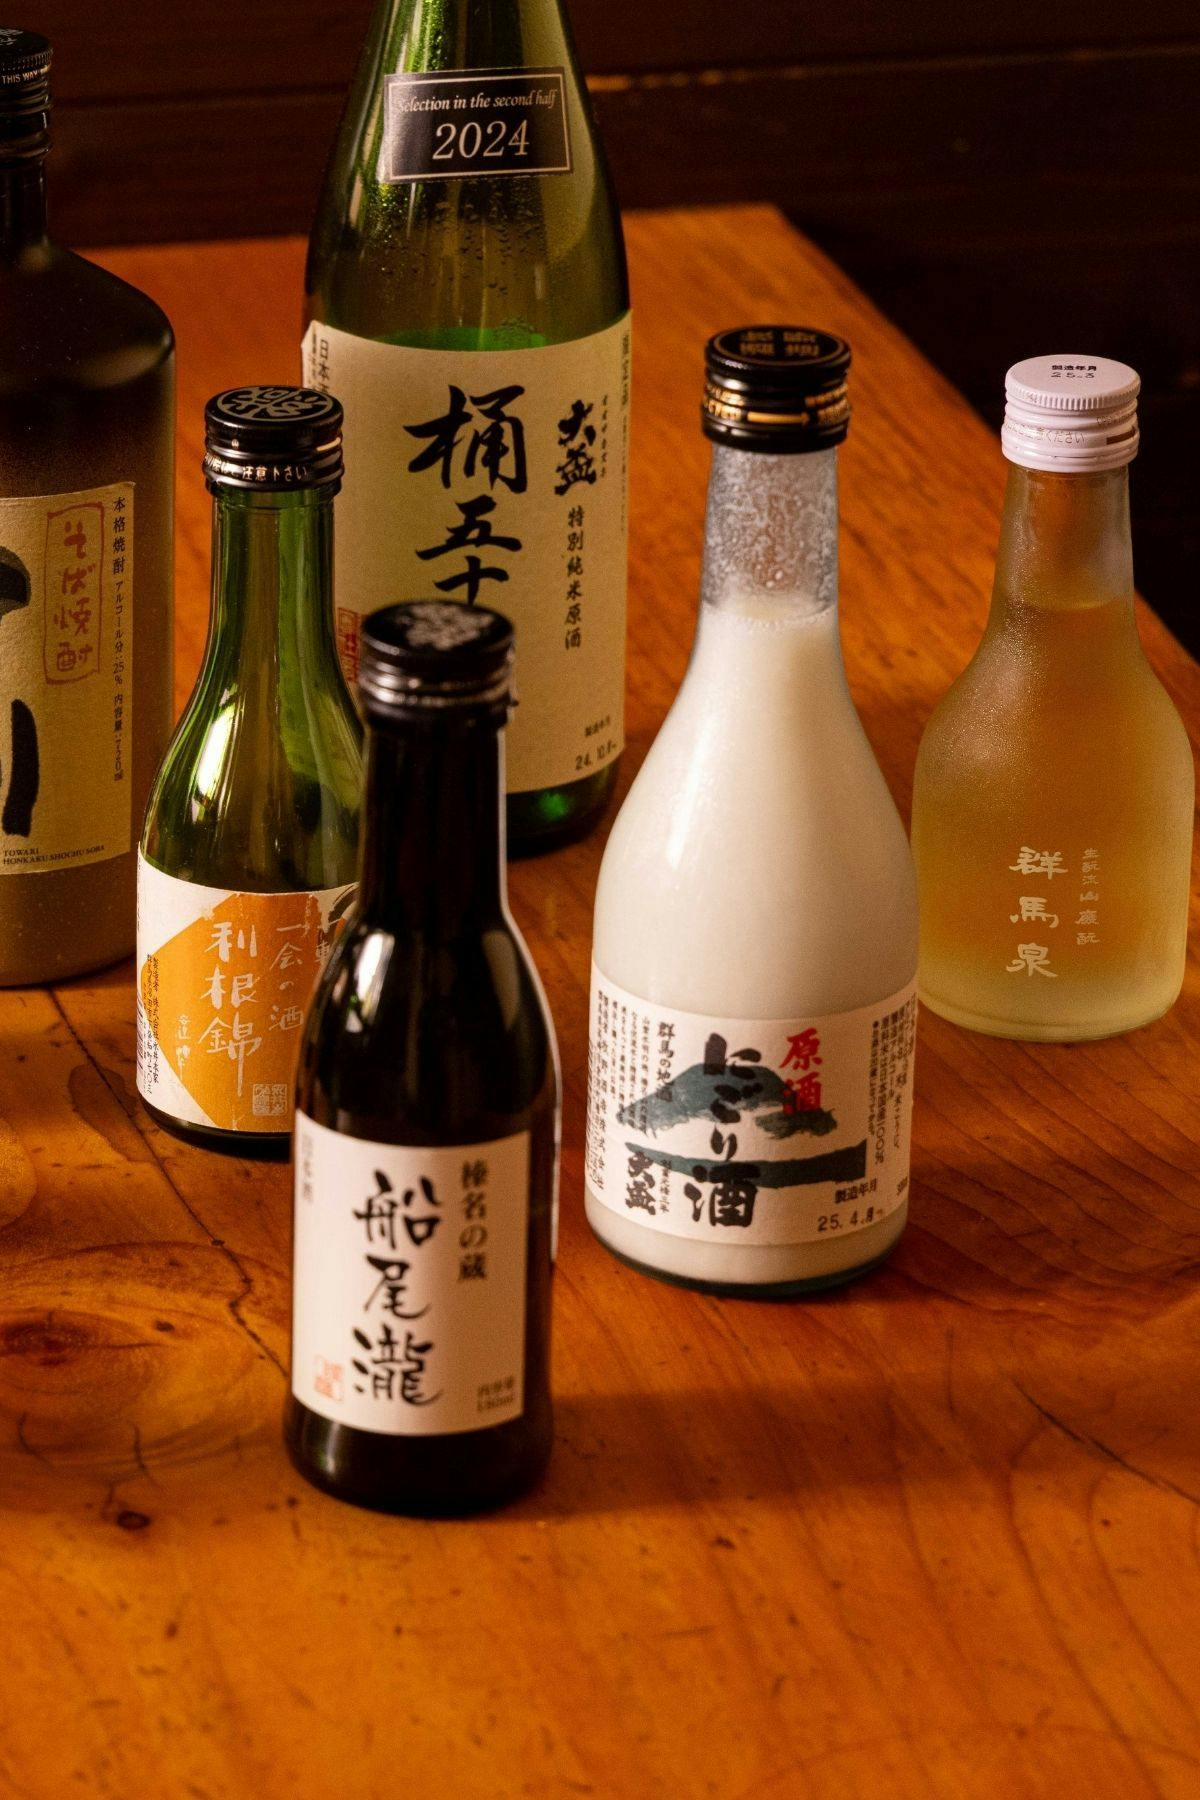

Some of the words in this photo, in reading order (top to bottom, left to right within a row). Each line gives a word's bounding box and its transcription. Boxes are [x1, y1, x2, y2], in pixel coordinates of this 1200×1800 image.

[2, 75, 21, 84] THIS
[22, 70, 39, 81] WAY
[399, 95, 450, 113] Selection
[453, 95, 466, 110] in
[470, 92, 490, 109] the
[493, 89, 534, 109] second
[535, 89, 558, 109] half
[432, 119, 530, 160] 2024
[113, 496, 126, 575] 本格焼酎
[564, 504, 585, 651] 特別純米原酒
[53, 521, 97, 673] そば焼酎
[1006, 846, 1069, 978] 群馬泉
[197, 920, 263, 1097] 利根錦
[779, 1027, 823, 1115] 原酒
[353, 1168, 445, 1405] 船尾瀧
